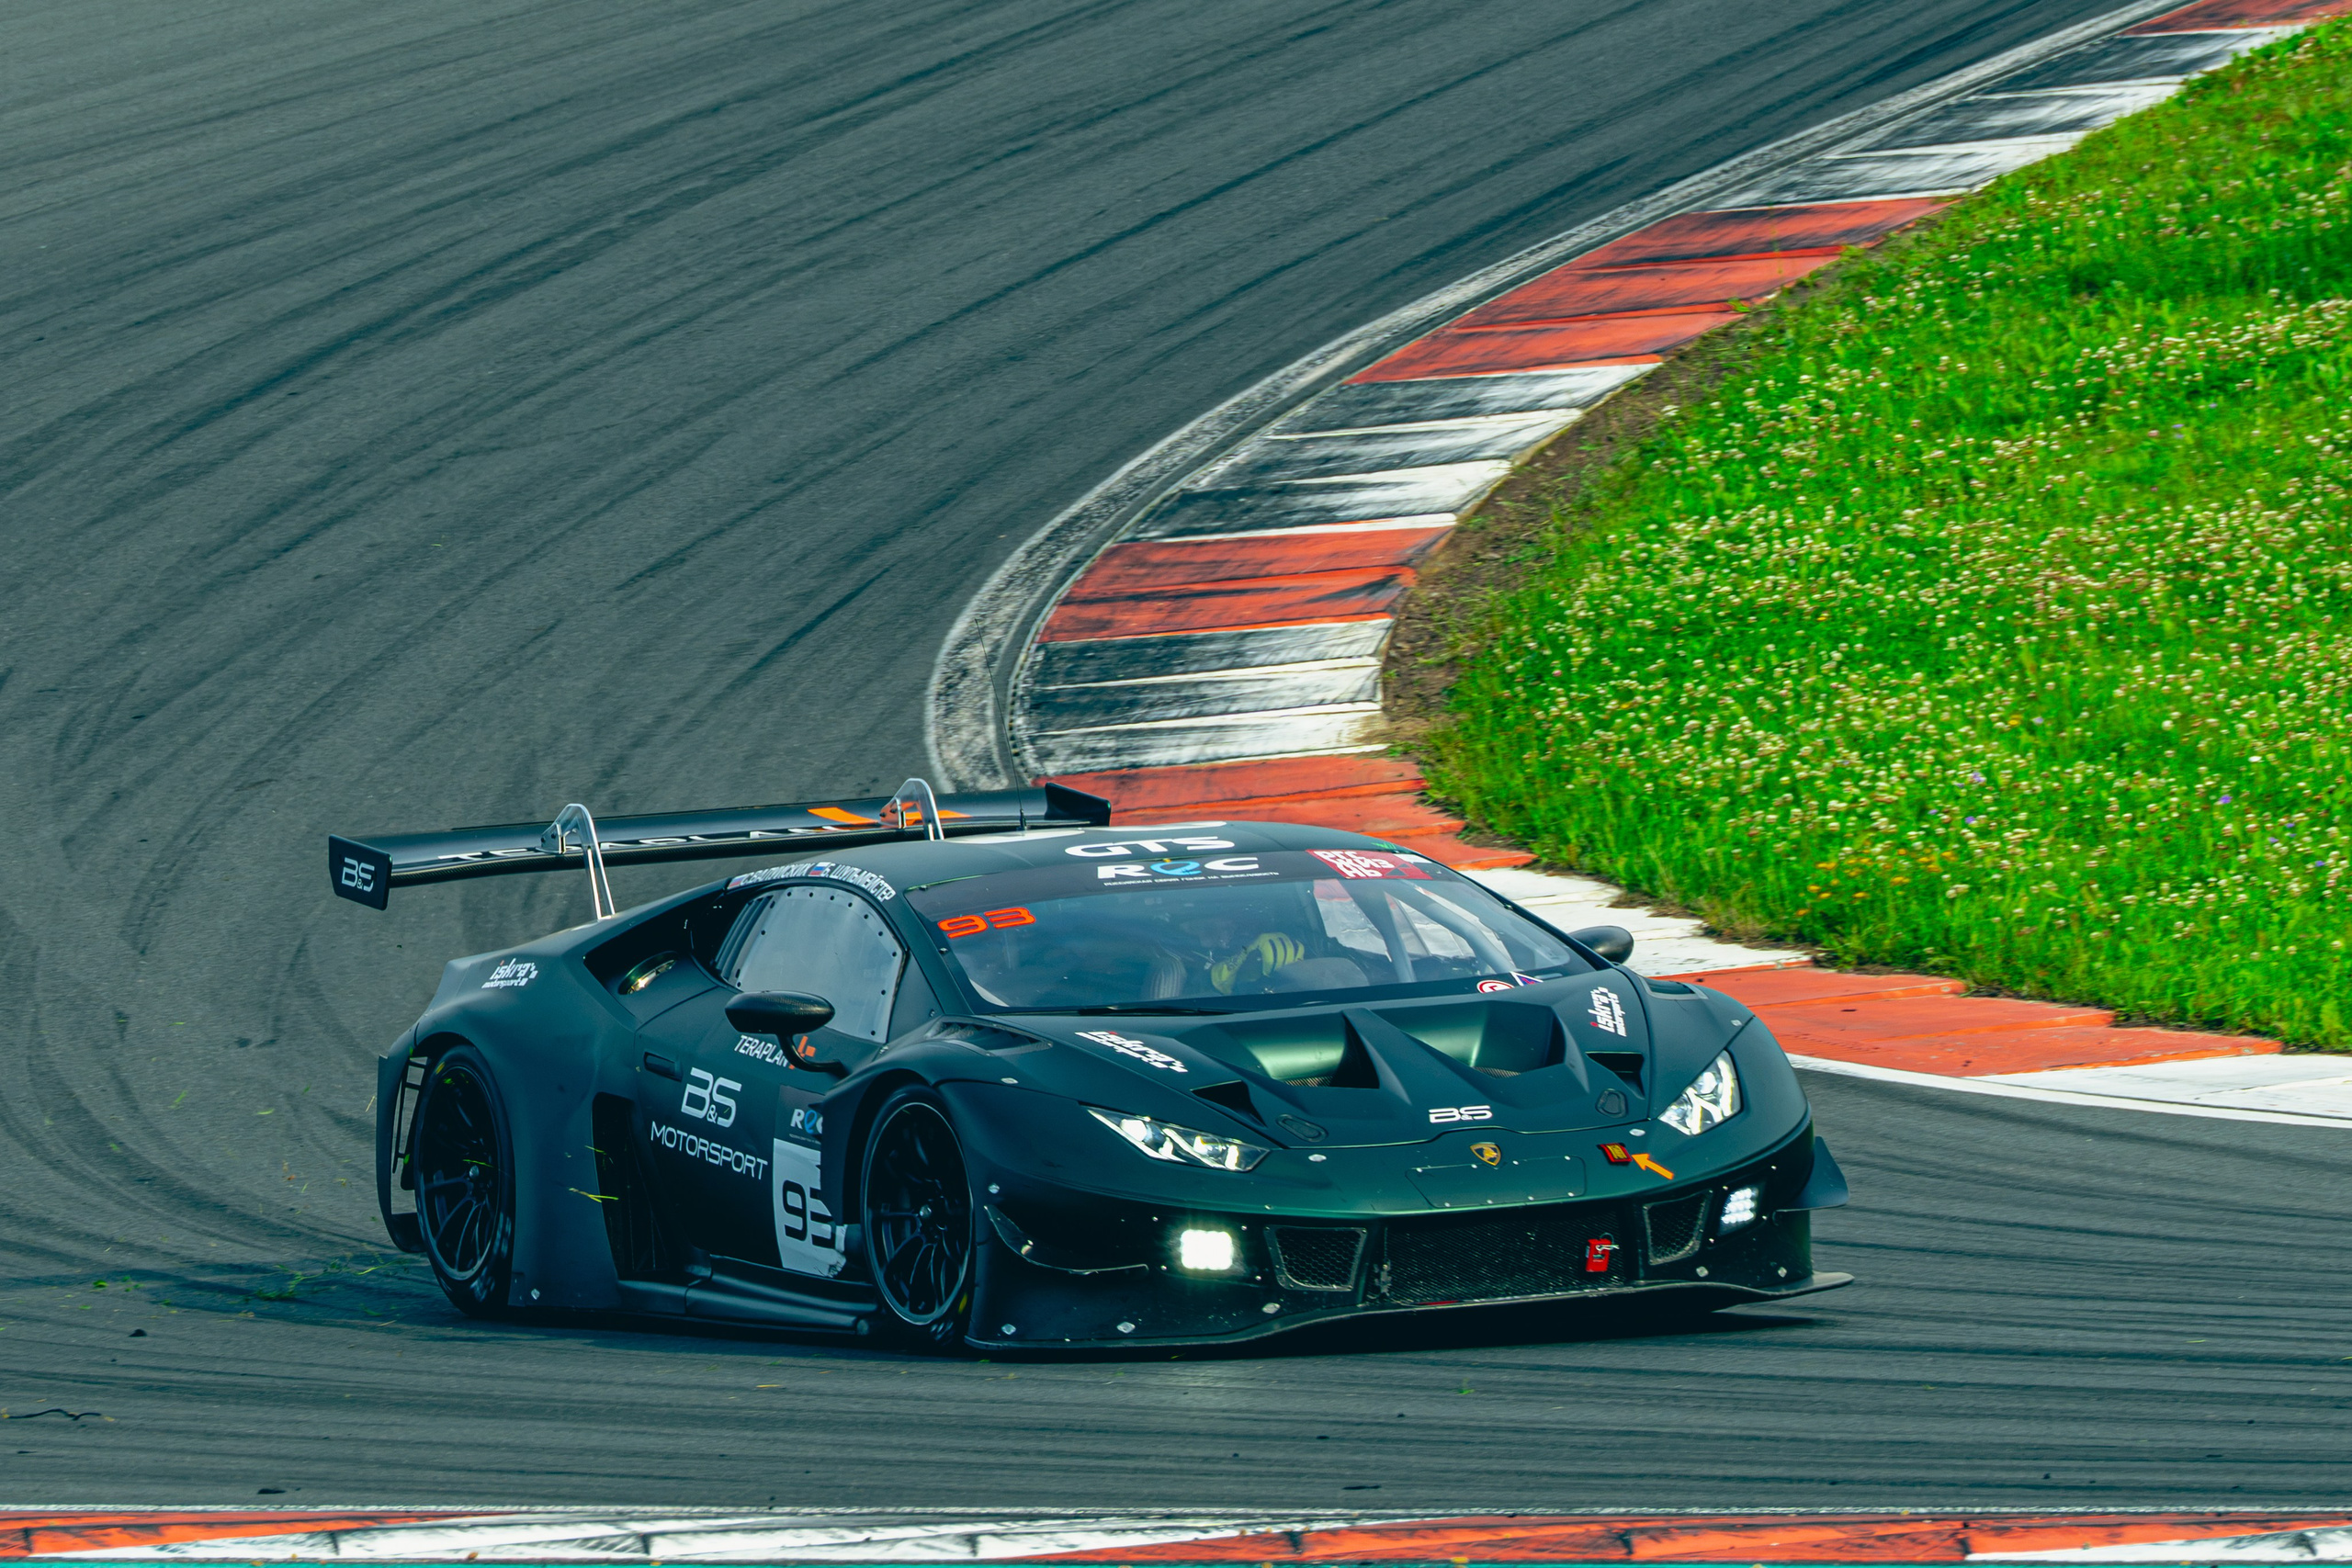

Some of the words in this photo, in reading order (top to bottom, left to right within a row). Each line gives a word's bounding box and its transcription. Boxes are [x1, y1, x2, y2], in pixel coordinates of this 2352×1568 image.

[1064, 836, 1235, 858] GTS
[341, 856, 376, 893] B&S
[937, 907, 1036, 939] 93
[681, 1066, 742, 1128] B&S
[1428, 1104, 1493, 1123] B&S
[650, 1120, 769, 1180] MOTORSPORT
